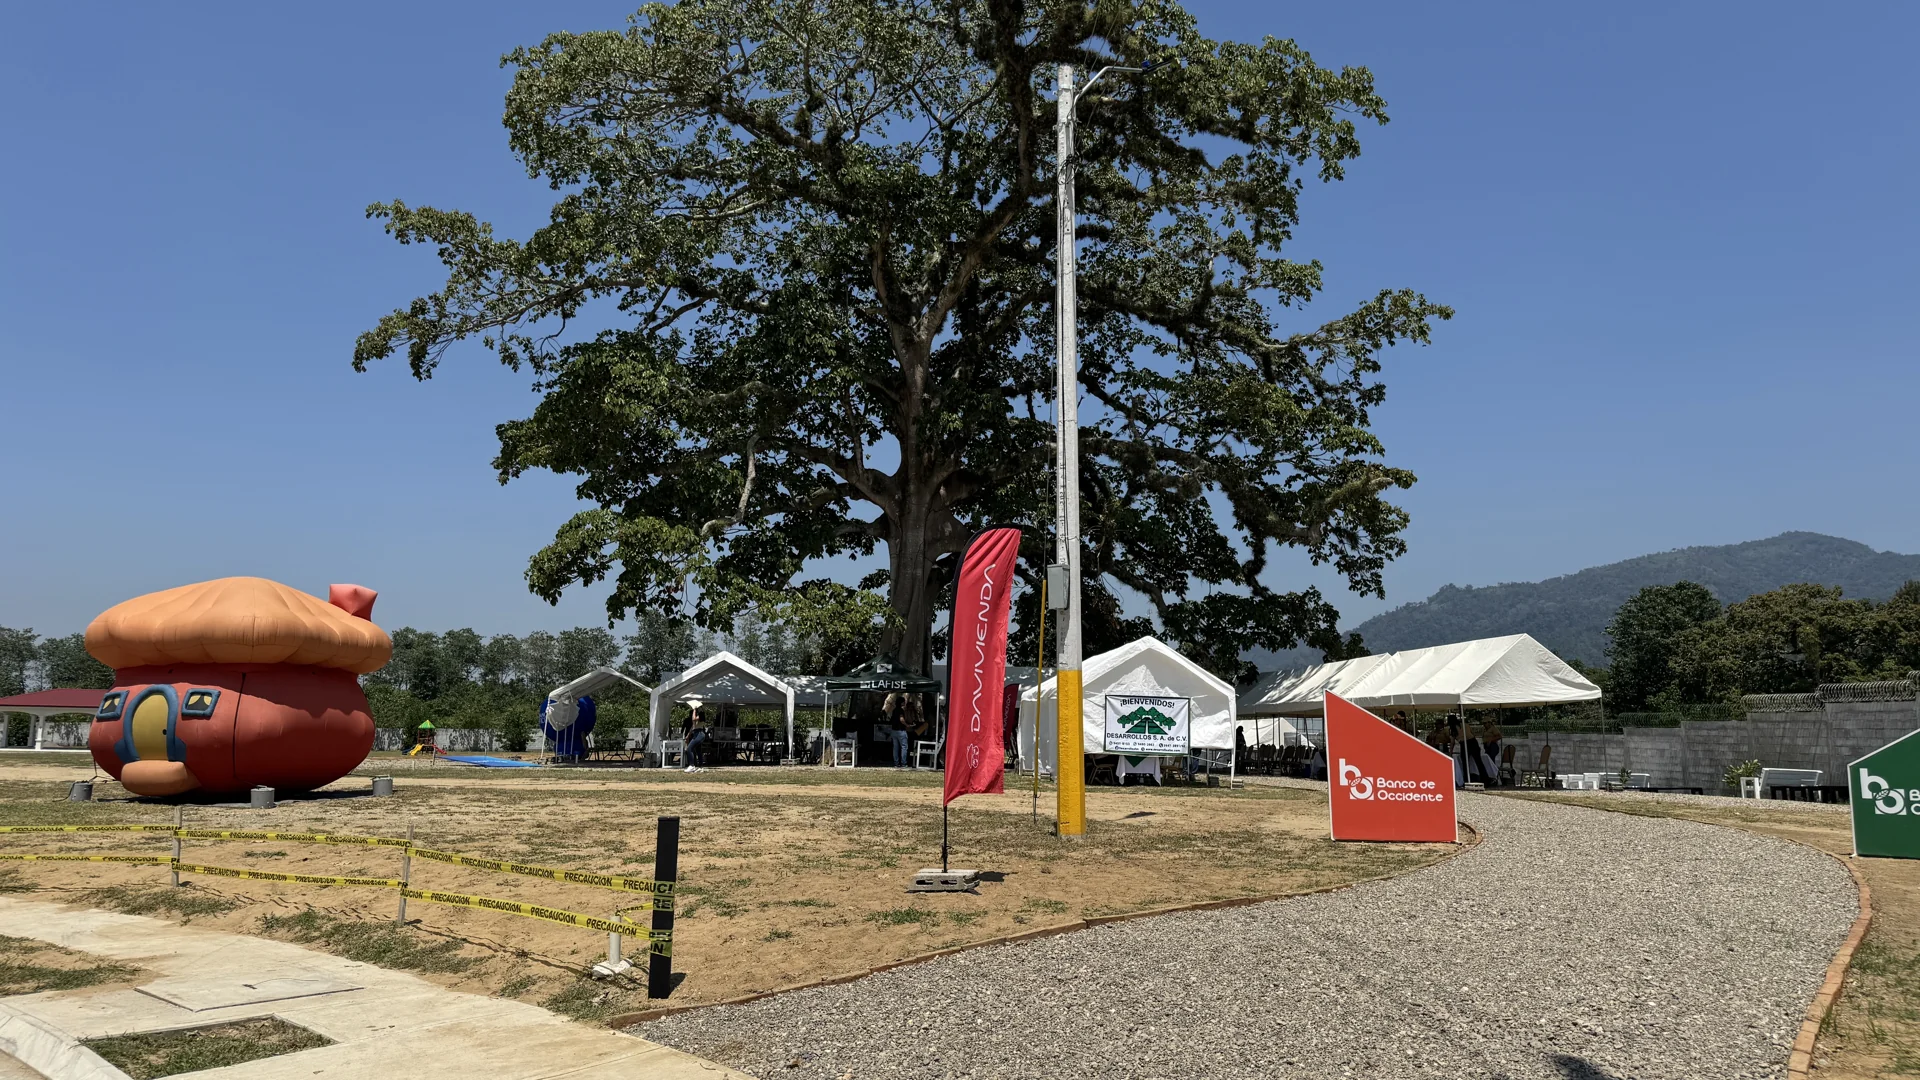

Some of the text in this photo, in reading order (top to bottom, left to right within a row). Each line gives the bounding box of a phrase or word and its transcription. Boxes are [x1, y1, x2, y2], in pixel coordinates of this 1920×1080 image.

[971, 563, 996, 733] DAVIVIENDA
[1120, 698, 1175, 708] ¡BIENVENIDOS!
[1376, 778, 1436, 789] Banco de
[1378, 790, 1444, 802] Occidente
